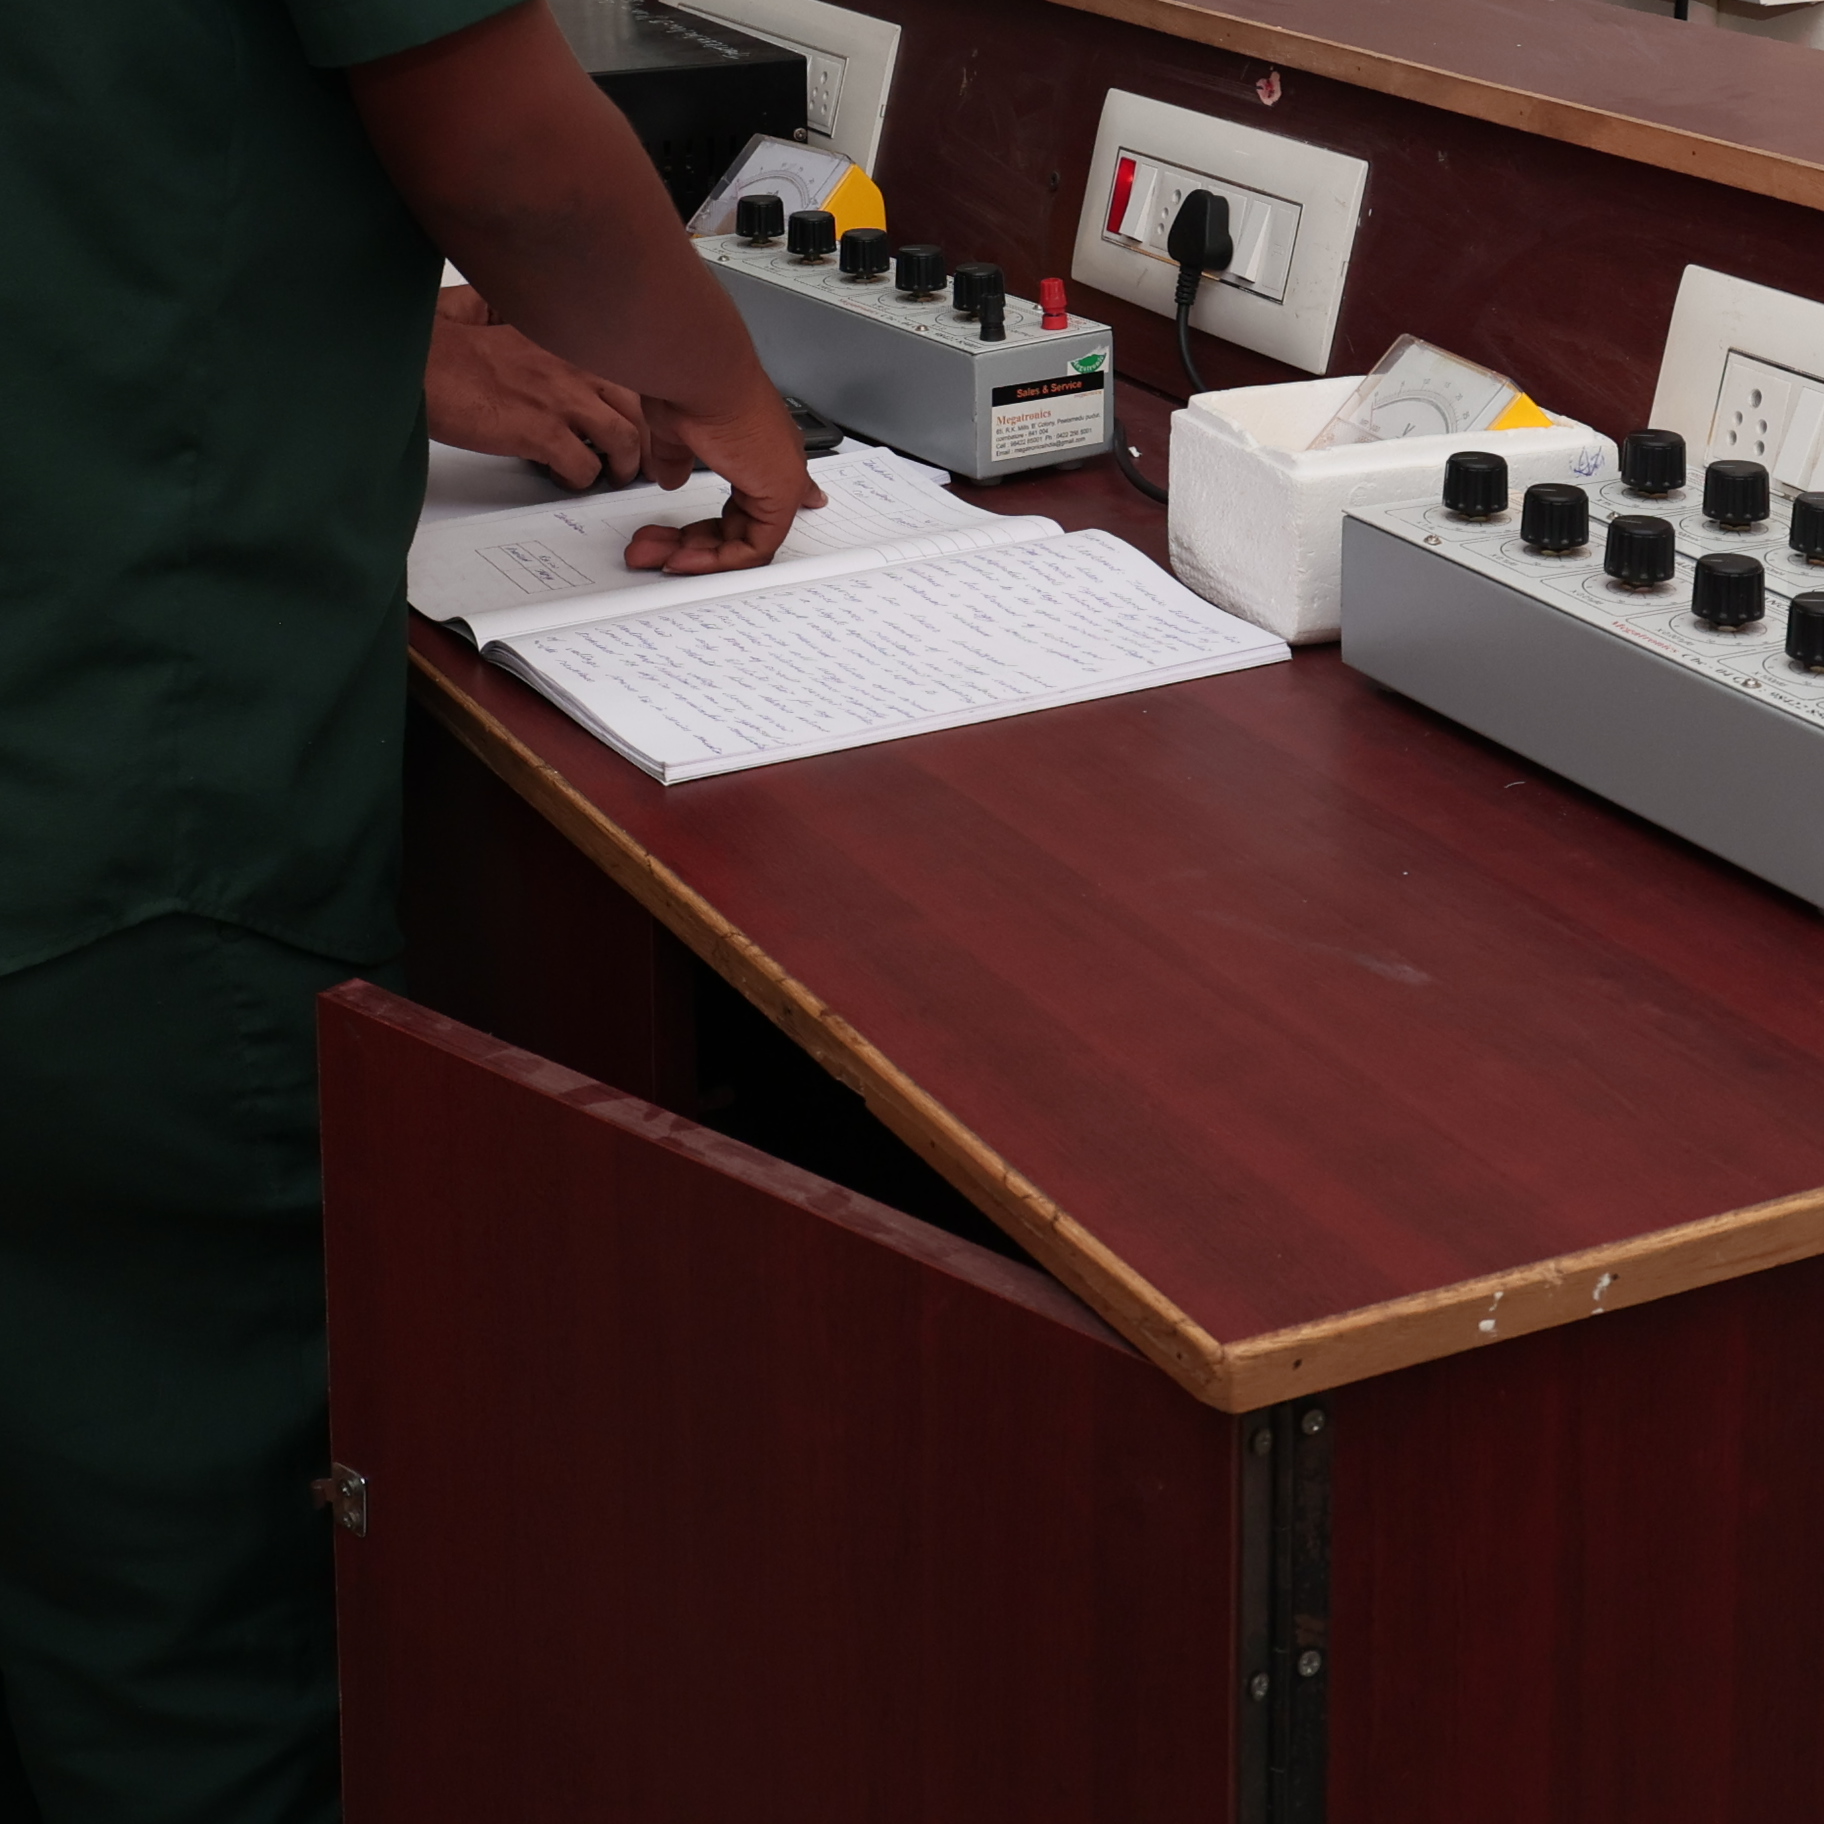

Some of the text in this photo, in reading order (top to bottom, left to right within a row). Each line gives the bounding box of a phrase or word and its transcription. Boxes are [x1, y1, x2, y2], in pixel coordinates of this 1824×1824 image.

[1016, 380, 1083, 398] Sales & Service
[996, 408, 1052, 427] Megatronics
[1611, 620, 1680, 655] Megatronics
